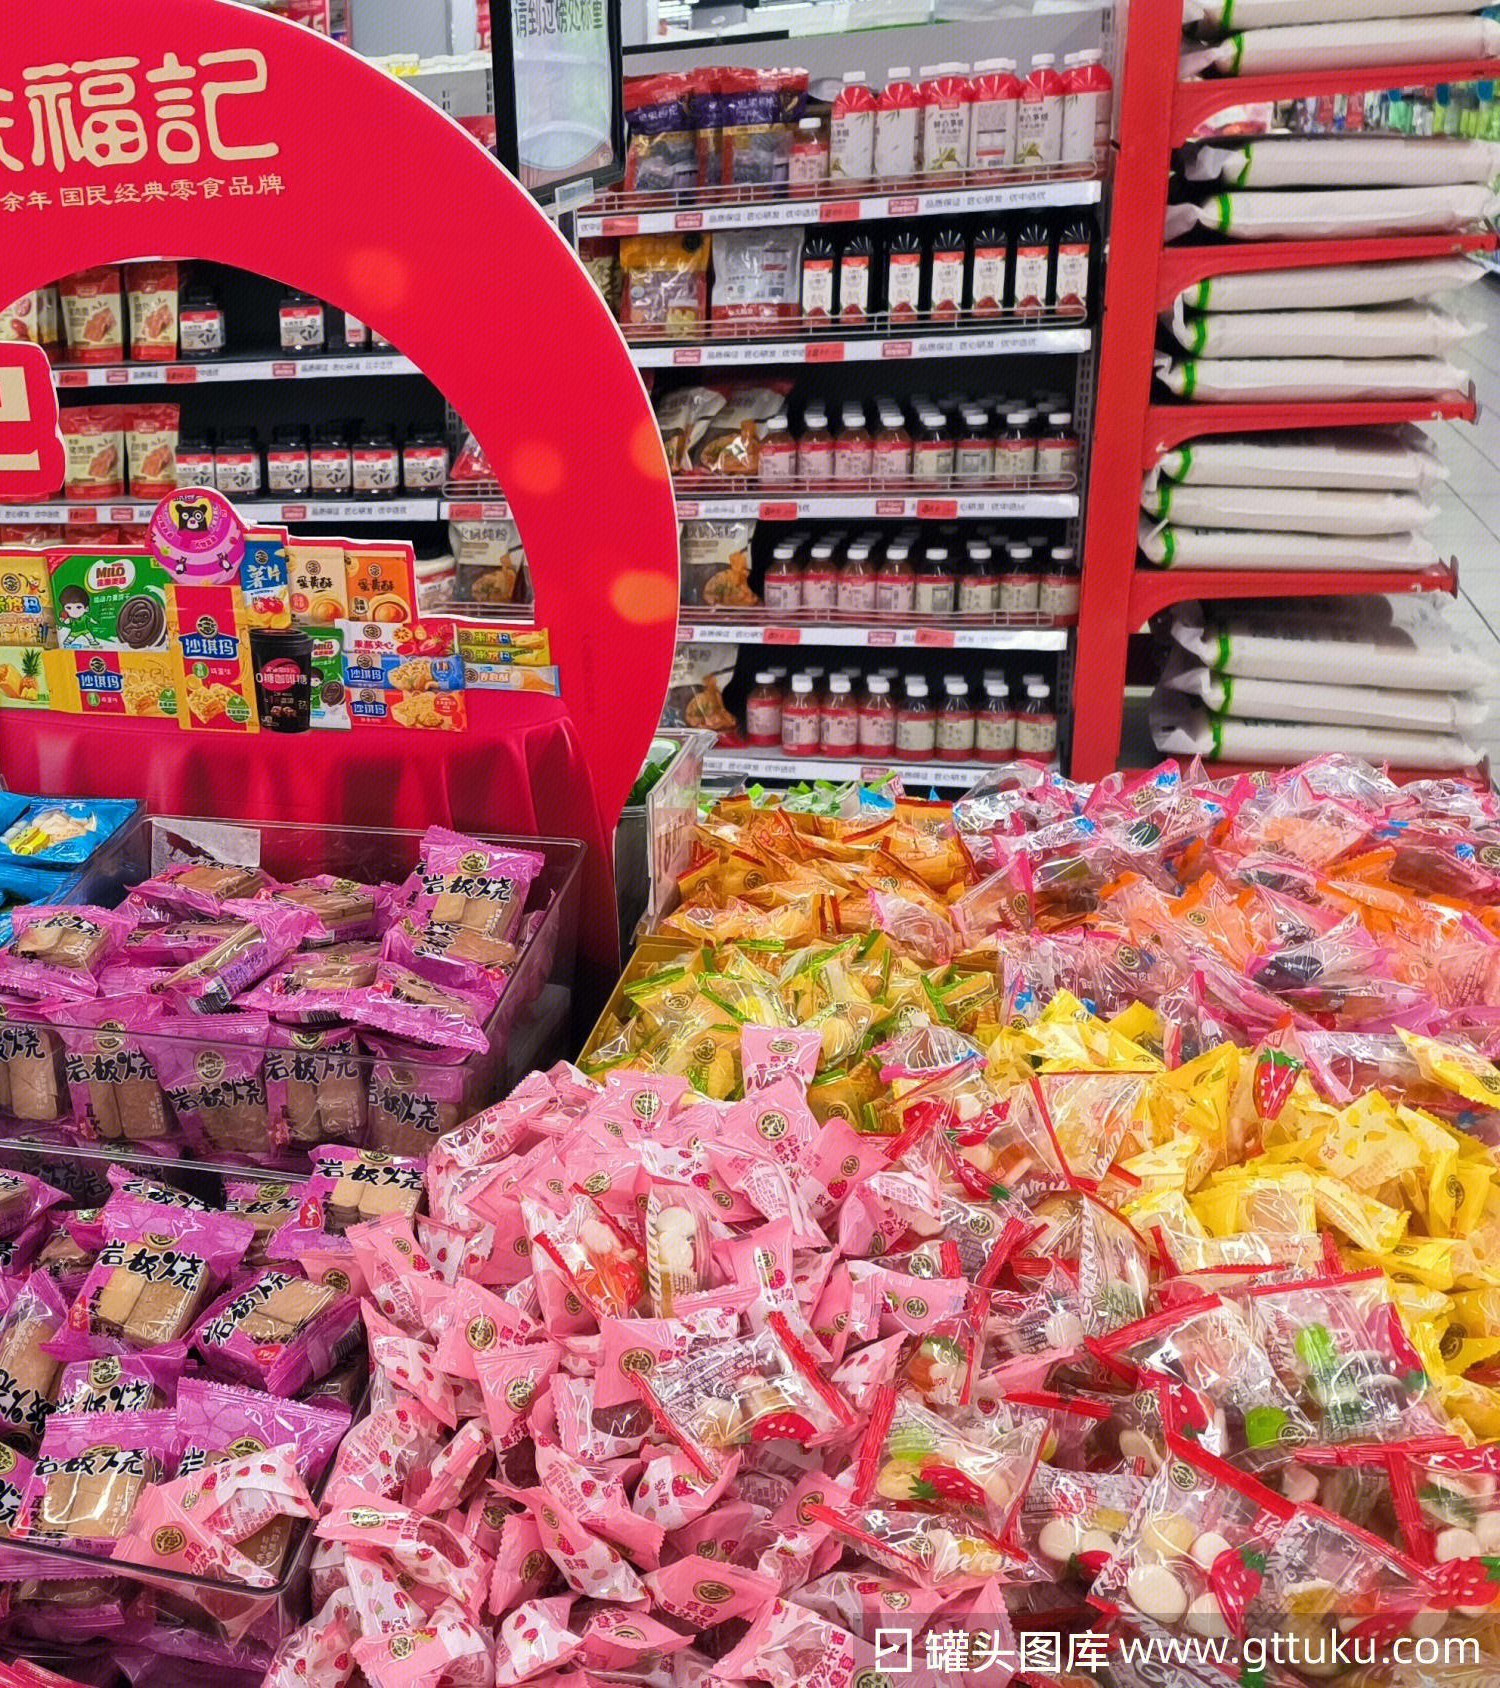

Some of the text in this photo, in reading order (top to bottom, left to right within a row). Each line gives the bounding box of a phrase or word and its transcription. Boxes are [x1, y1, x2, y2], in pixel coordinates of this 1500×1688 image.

[59, 172, 286, 208] 国民经典零食品牌
[95, 566, 126, 579] MILO
[246, 564, 280, 588] 薯片
[185, 638, 234, 656] 沙琪玛
[80, 674, 120, 689] 沙琪玛
[423, 874, 512, 902] 岩板烧
[65, 1053, 159, 1084] 岩板烧
[316, 1158, 424, 1190] 岩板烧
[98, 1240, 206, 1292] 岩板烧
